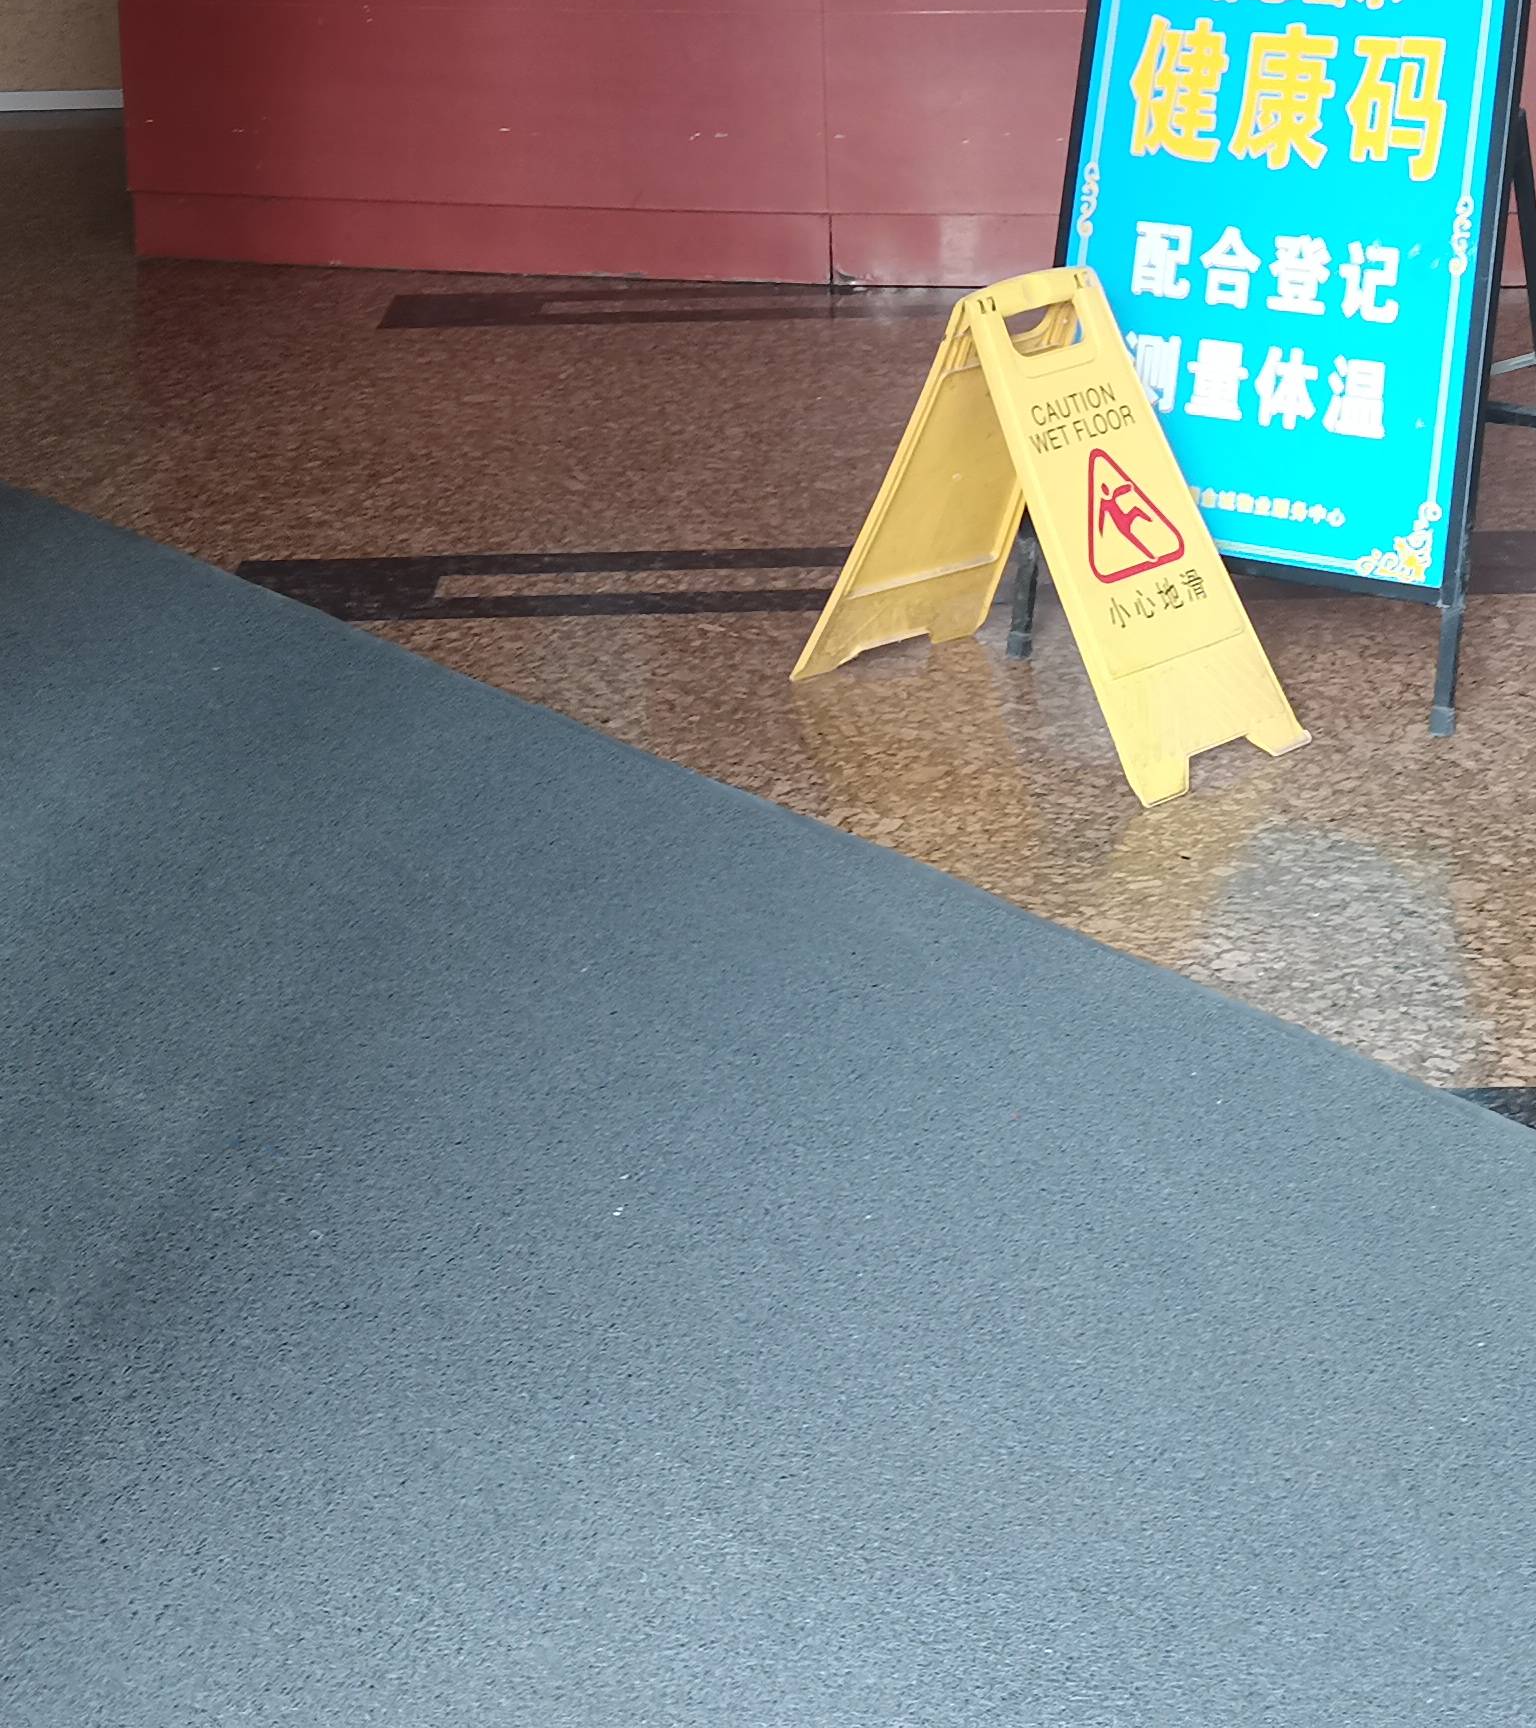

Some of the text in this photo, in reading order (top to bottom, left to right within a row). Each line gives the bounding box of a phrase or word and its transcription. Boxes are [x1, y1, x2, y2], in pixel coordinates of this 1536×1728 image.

[1129, 13, 1447, 183] 健康码
[1130, 219, 1401, 325] 配合登记
[1028, 403, 1137, 455] WET FLOOR
[1031, 382, 1116, 427] CAUTION
[1108, 568, 1208, 629] 小心地滑
